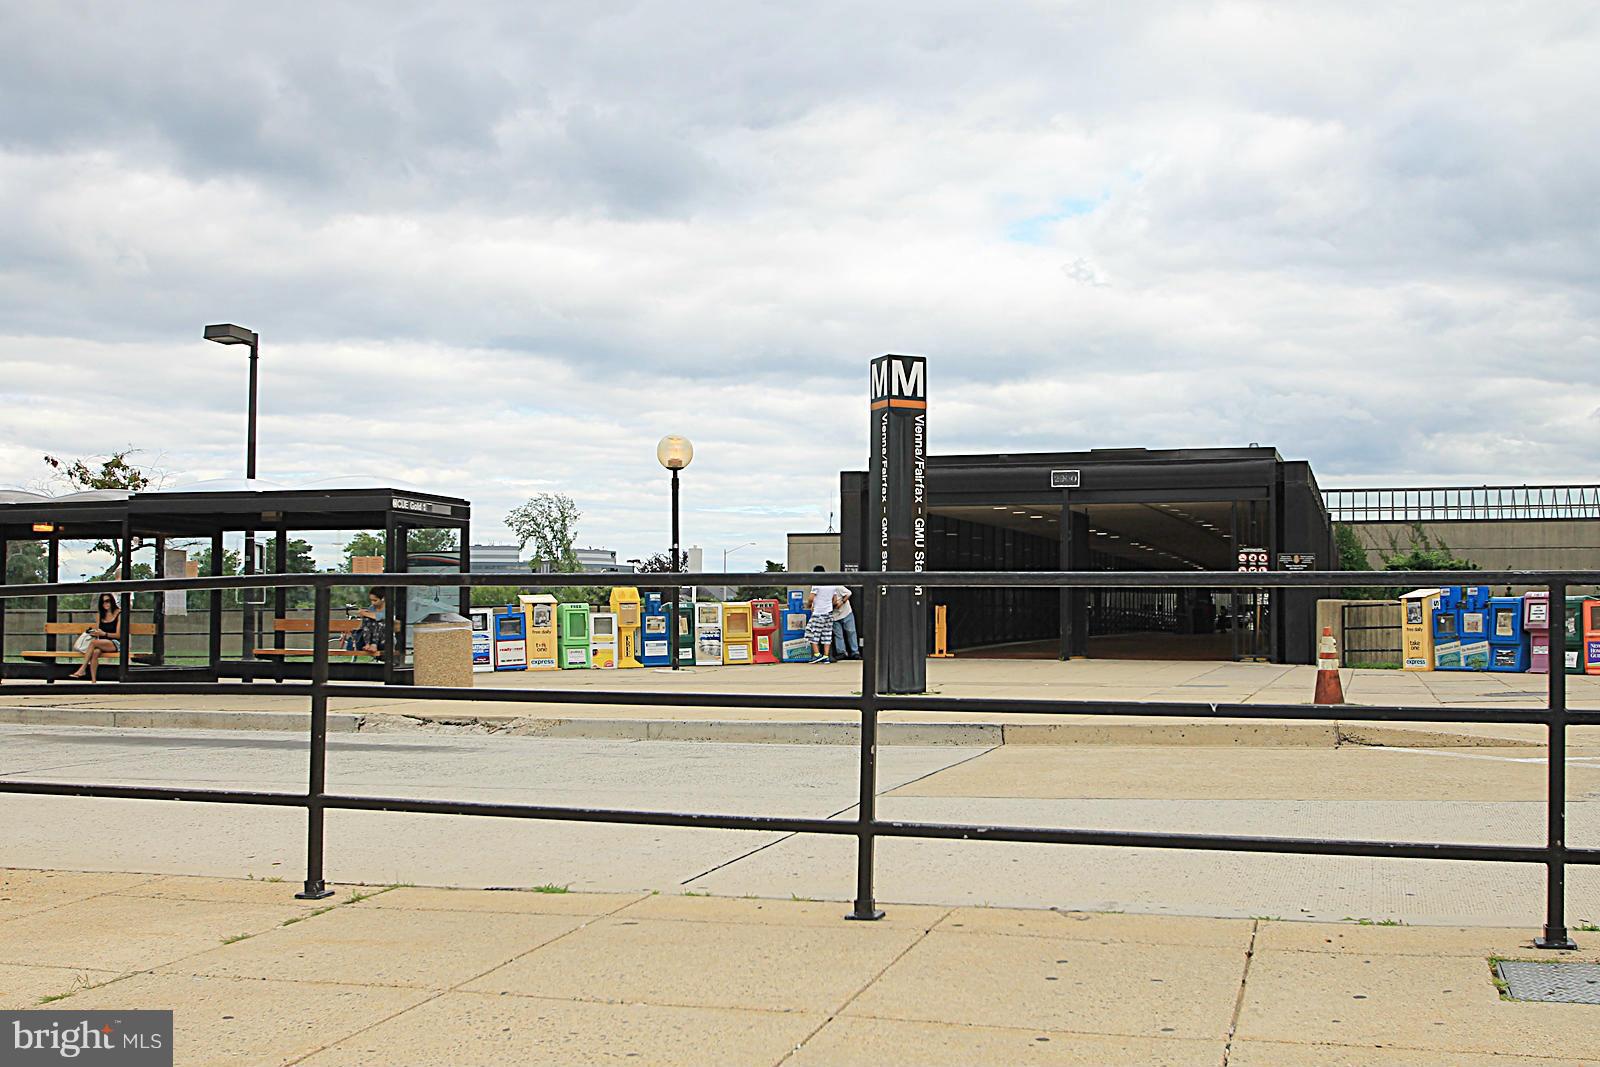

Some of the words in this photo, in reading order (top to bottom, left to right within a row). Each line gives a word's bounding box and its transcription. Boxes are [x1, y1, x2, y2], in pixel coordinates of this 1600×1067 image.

[872, 360, 888, 399] M
[892, 359, 924, 397] M
[914, 414, 925, 503] Vienna/Fairfax
[914, 517, 925, 548] GMU
[914, 551, 925, 596] Stan
